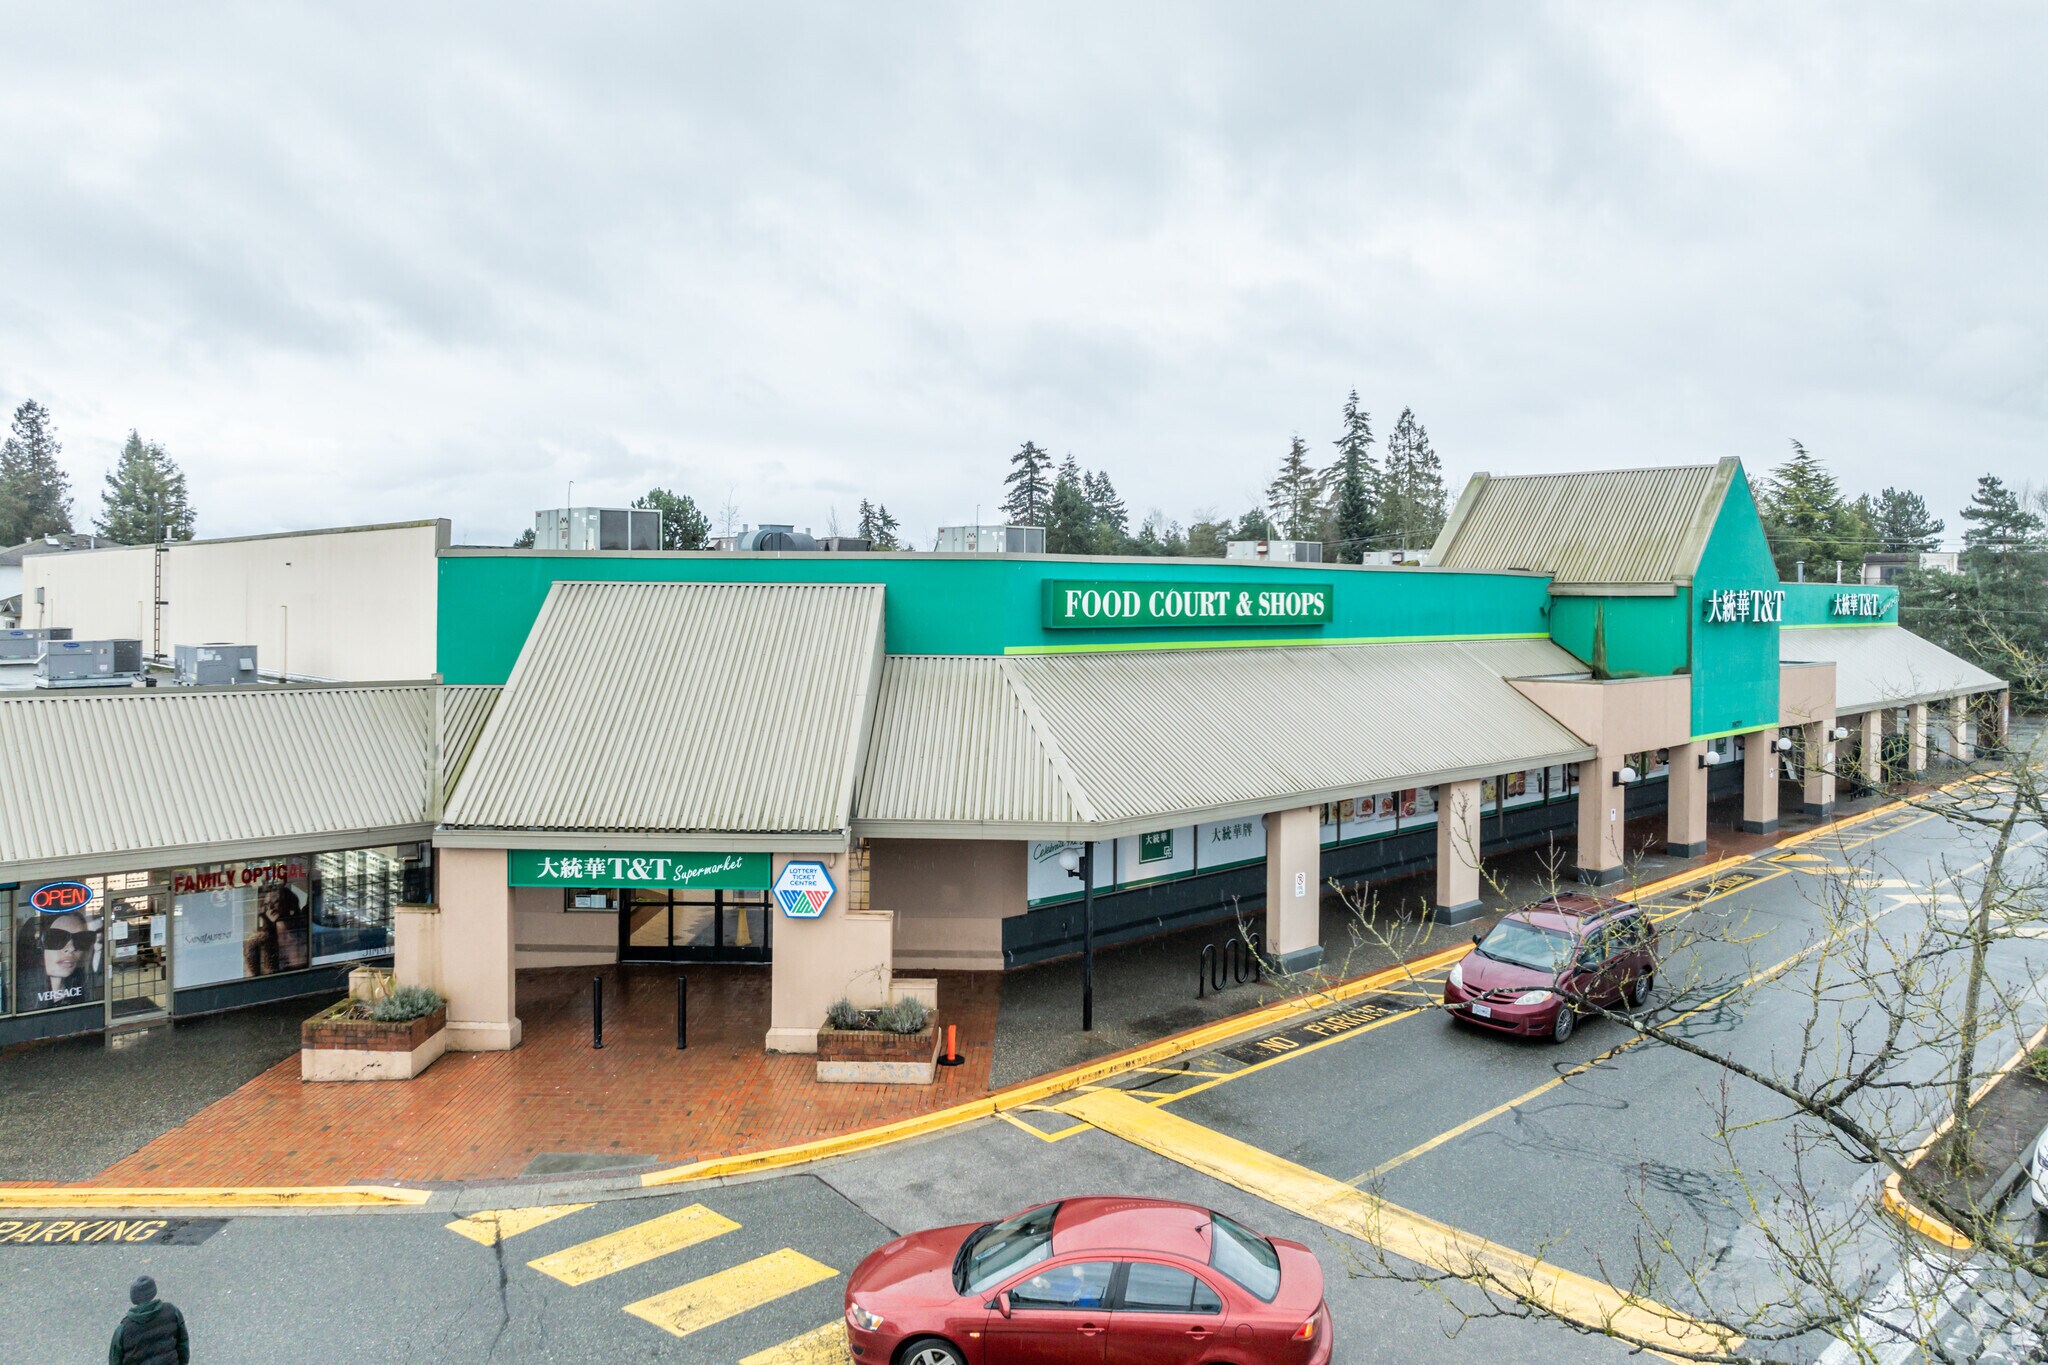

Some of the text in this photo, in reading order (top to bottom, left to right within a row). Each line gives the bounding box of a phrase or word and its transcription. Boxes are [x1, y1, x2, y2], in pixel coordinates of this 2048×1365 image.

[1065, 590, 1324, 617] FOOD COURT & SHOPS
[1708, 589, 1785, 623] 大統華 T&T
[1833, 593, 1858, 616] 大統華
[1858, 593, 1879, 616] T&T
[175, 863, 307, 893] FAMILY OPTICAL
[537, 855, 743, 884] 大統華 T&T Supermarket
[33, 888, 85, 907] OPEN
[38, 987, 82, 1001] VERSACE
[1257, 1004, 1388, 1053] NO PARKING
